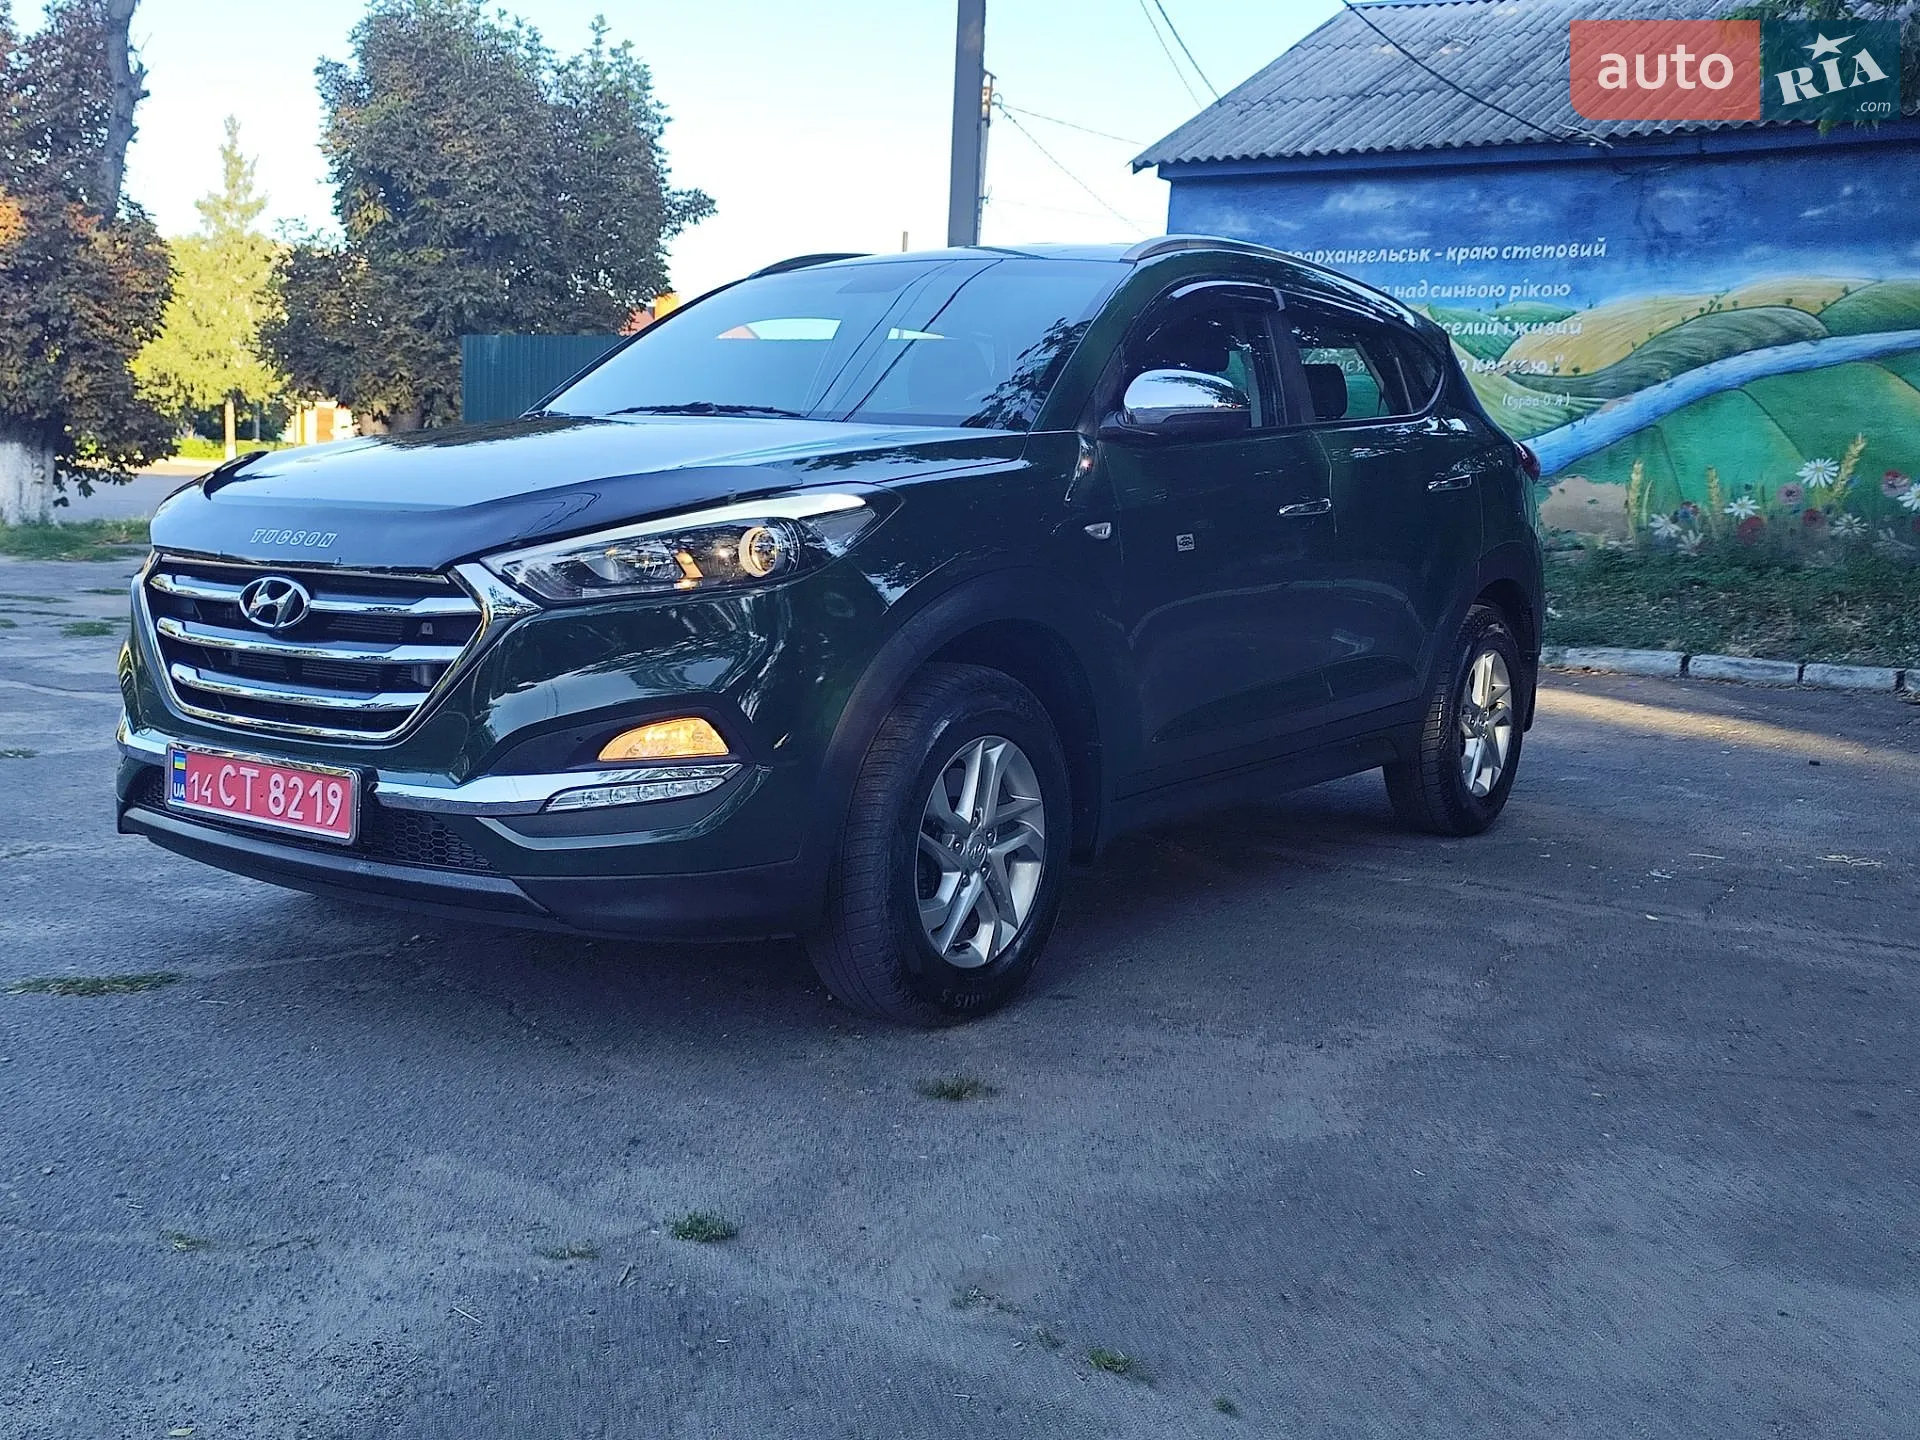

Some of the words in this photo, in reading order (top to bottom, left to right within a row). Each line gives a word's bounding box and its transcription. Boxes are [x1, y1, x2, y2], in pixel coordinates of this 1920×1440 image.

[1446, 243, 1498, 265] краю
[1502, 237, 1608, 260] степовий
[1394, 279, 1429, 299] над
[1430, 283, 1506, 299] синьою
[1509, 279, 1571, 301] рікою
[1437, 316, 1500, 337] селий
[1511, 317, 1583, 338] живий
[250, 528, 338, 549] TUCSON
[173, 783, 186, 799] UA
[268, 772, 343, 826] 8219
